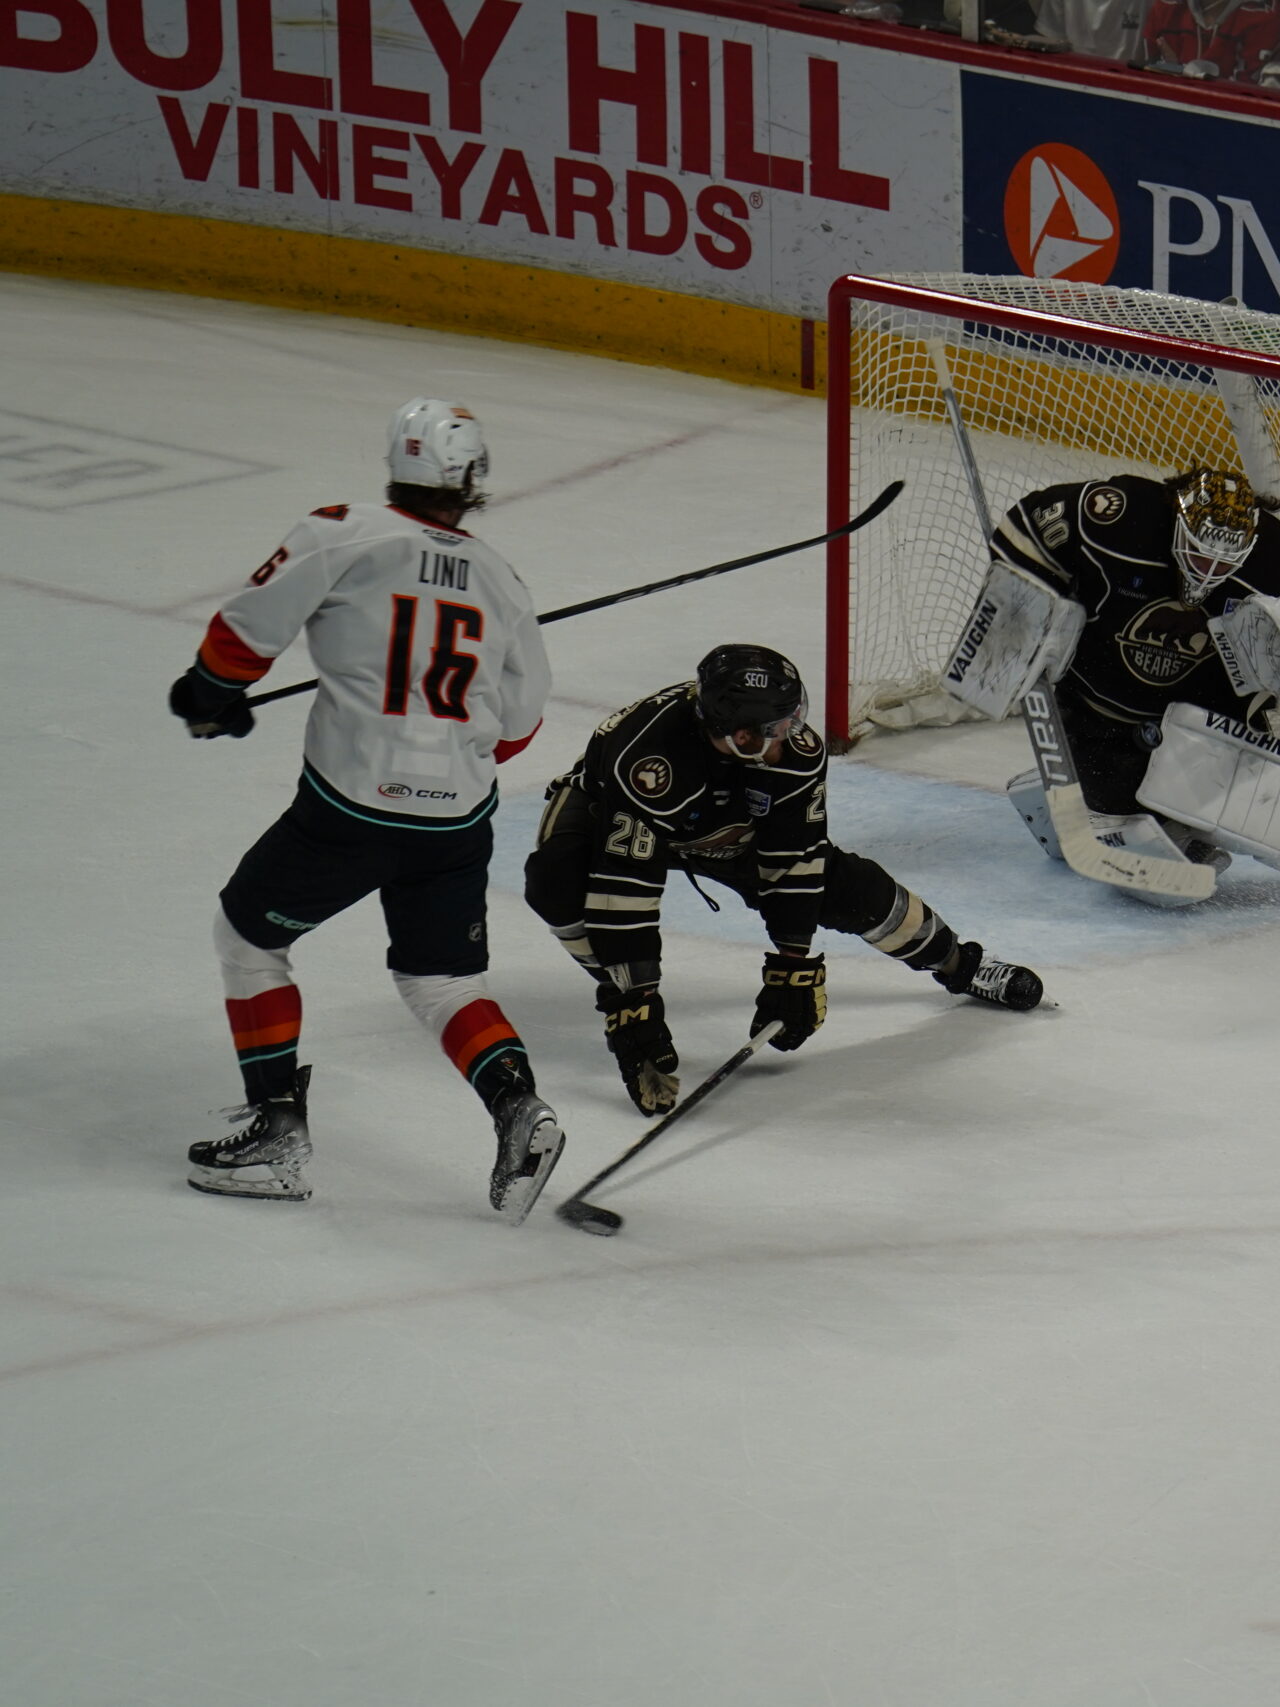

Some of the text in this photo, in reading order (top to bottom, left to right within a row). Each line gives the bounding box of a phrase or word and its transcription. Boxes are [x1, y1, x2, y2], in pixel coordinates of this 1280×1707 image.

[566, 11, 891, 211] HILL
[1029, 499, 1070, 550] 30
[419, 550, 470, 592] LIND
[383, 593, 485, 722] 16
[948, 599, 998, 683] VAUGHN
[1133, 649, 1182, 678] BEARS
[1213, 631, 1246, 688] VAUGHN
[743, 672, 769, 689] SECU
[415, 789, 458, 800] CCM
[605, 811, 656, 861] 28
